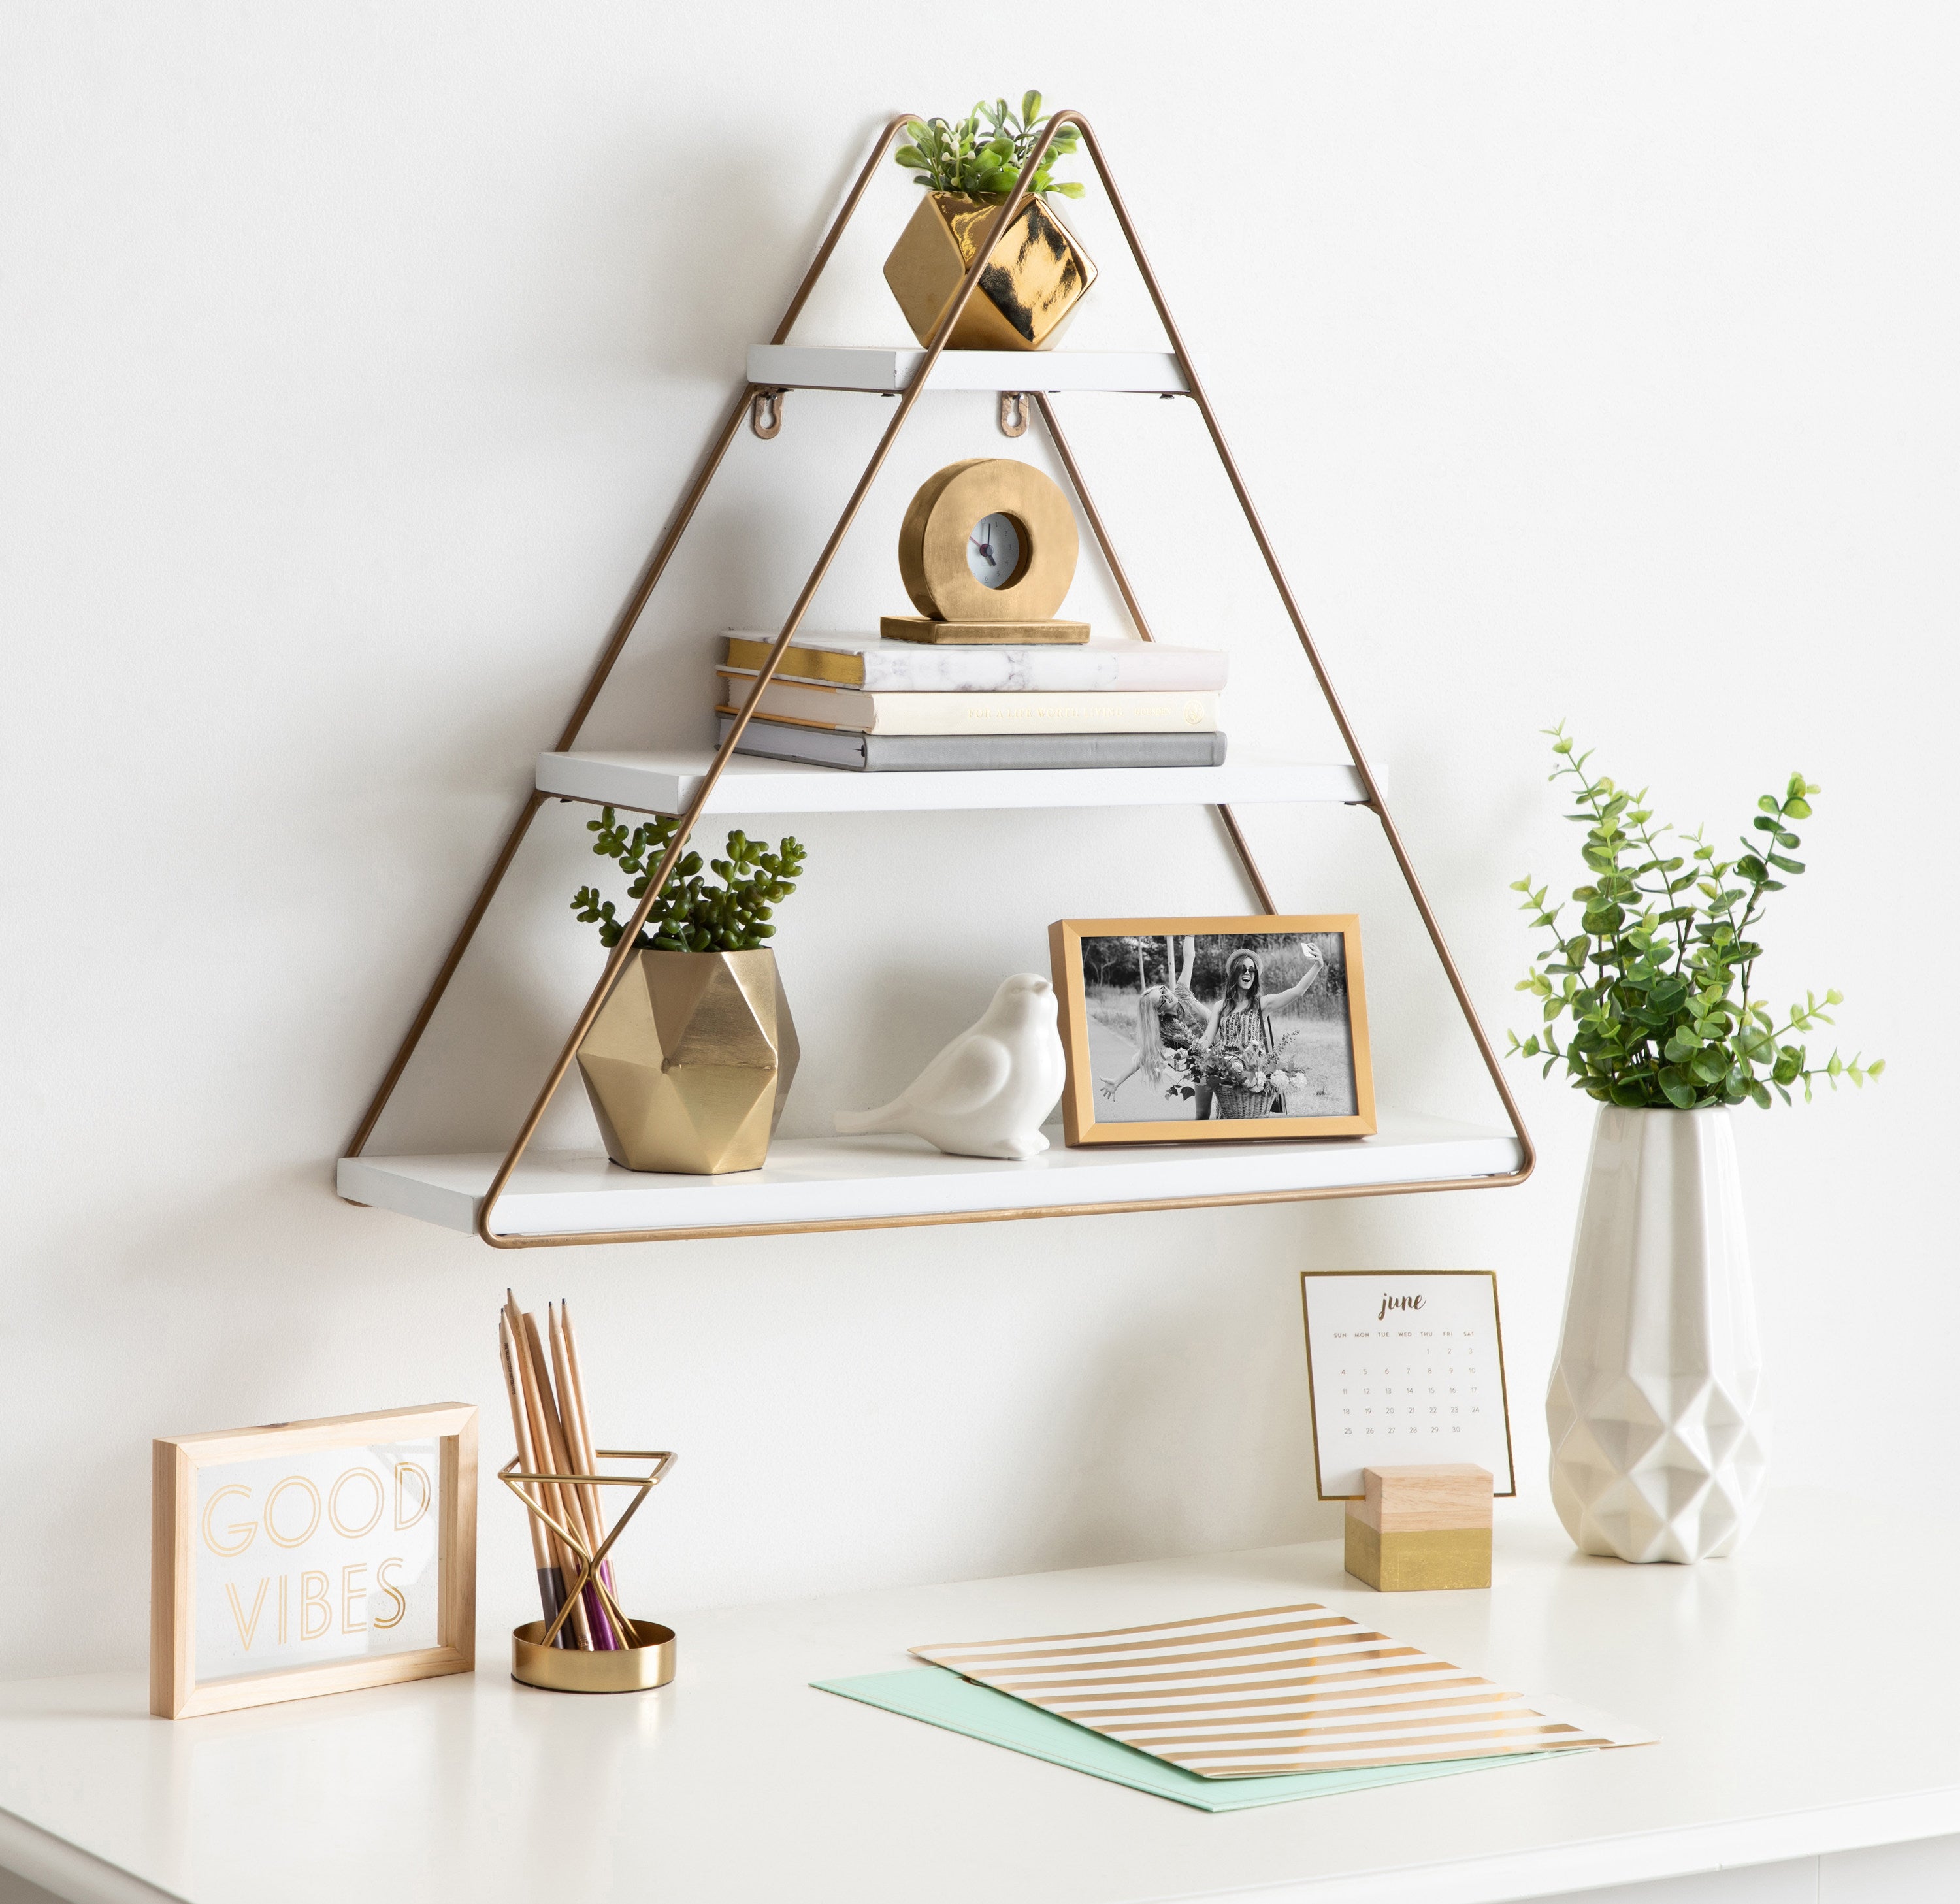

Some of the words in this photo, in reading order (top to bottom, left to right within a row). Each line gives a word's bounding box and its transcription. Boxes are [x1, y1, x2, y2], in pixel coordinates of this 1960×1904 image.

[968, 707, 991, 719] FOR
[996, 707, 1004, 718] A
[1007, 707, 1033, 718] LIFE
[1037, 706, 1079, 718] WORTH
[1083, 706, 1124, 718] LIVING
[1378, 1293, 1426, 1321] june
[201, 1461, 431, 1558] GOOD
[224, 1556, 406, 1652] VIBES
